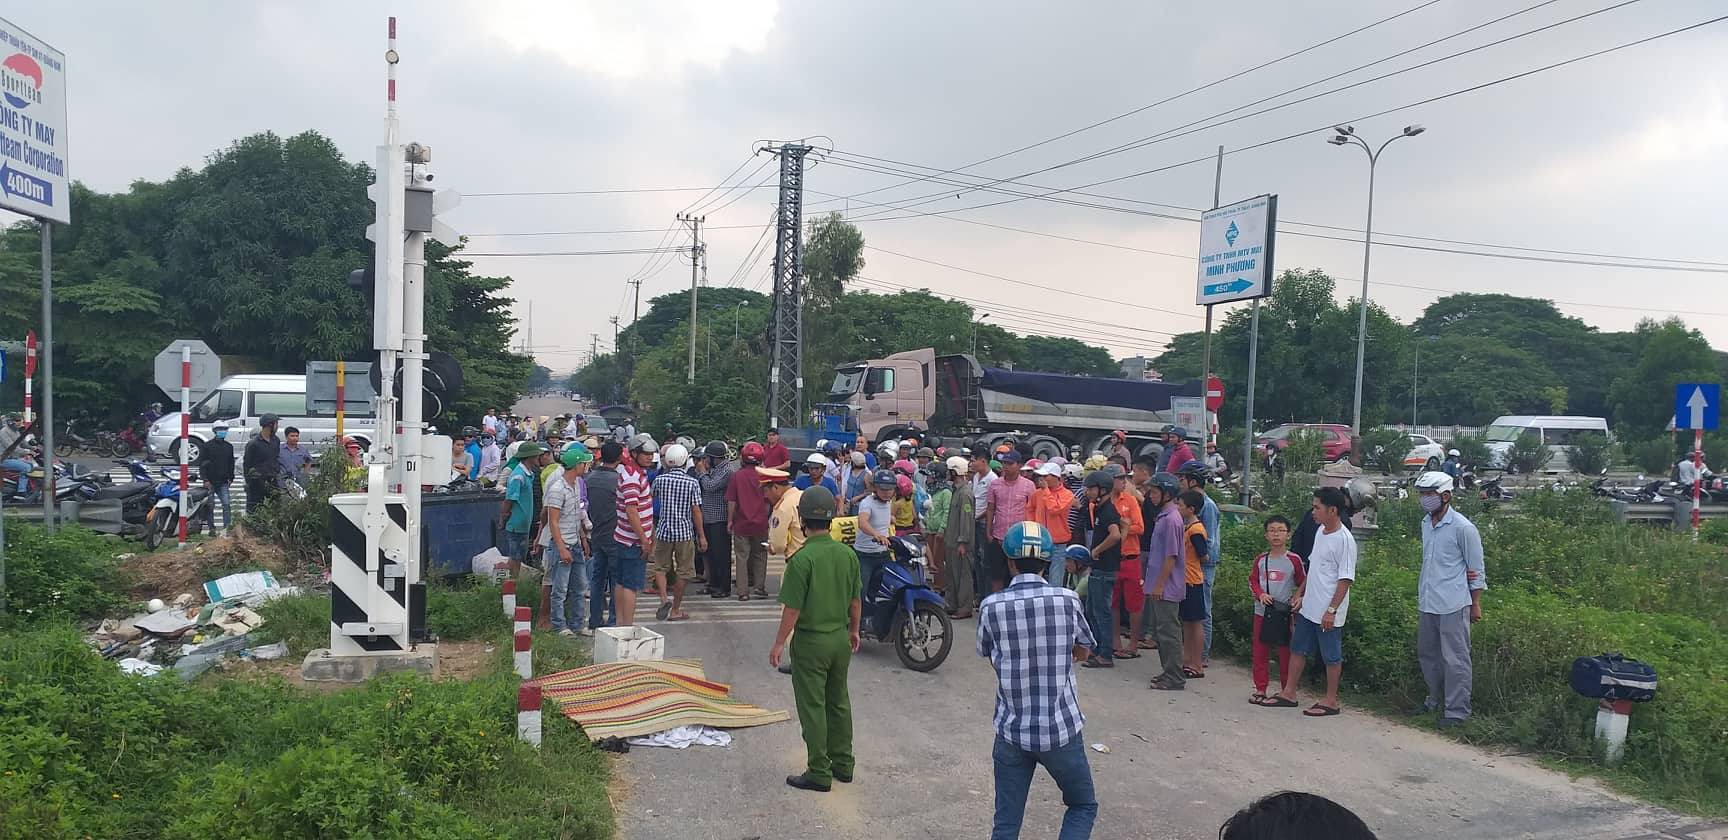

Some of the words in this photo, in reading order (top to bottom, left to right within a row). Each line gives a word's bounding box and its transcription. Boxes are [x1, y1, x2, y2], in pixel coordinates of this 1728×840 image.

[22, 114, 32, 136] TY
[36, 121, 54, 146] MAY
[24, 140, 63, 177] Corporation
[8, 171, 44, 200] 400m
[1207, 264, 1224, 276] MINH
